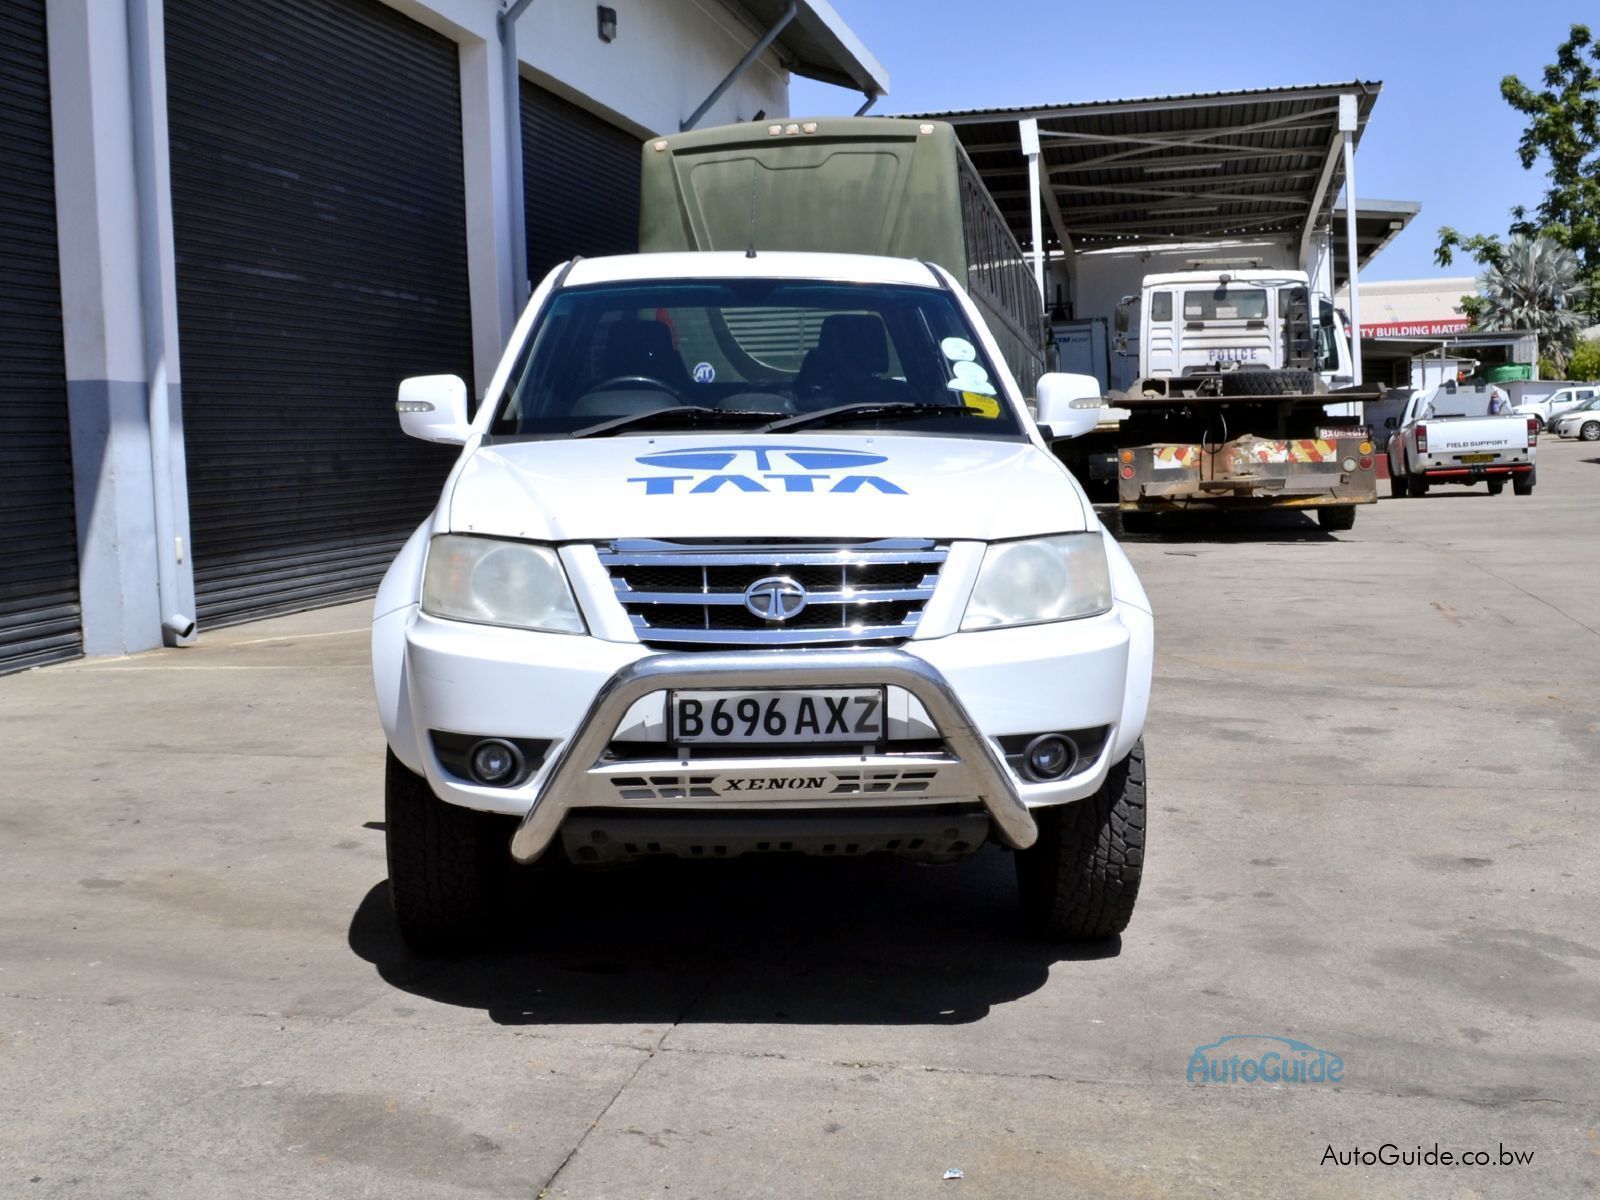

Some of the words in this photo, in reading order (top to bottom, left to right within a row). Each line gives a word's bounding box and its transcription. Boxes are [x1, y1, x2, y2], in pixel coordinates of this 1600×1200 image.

[1376, 325, 1429, 337] BUILDING
[1208, 348, 1257, 361] POLICE
[1446, 441, 1469, 449] FIELD
[1470, 439, 1508, 447] SUPPORT
[627, 474, 910, 495] TATA
[723, 776, 827, 791] XENON
